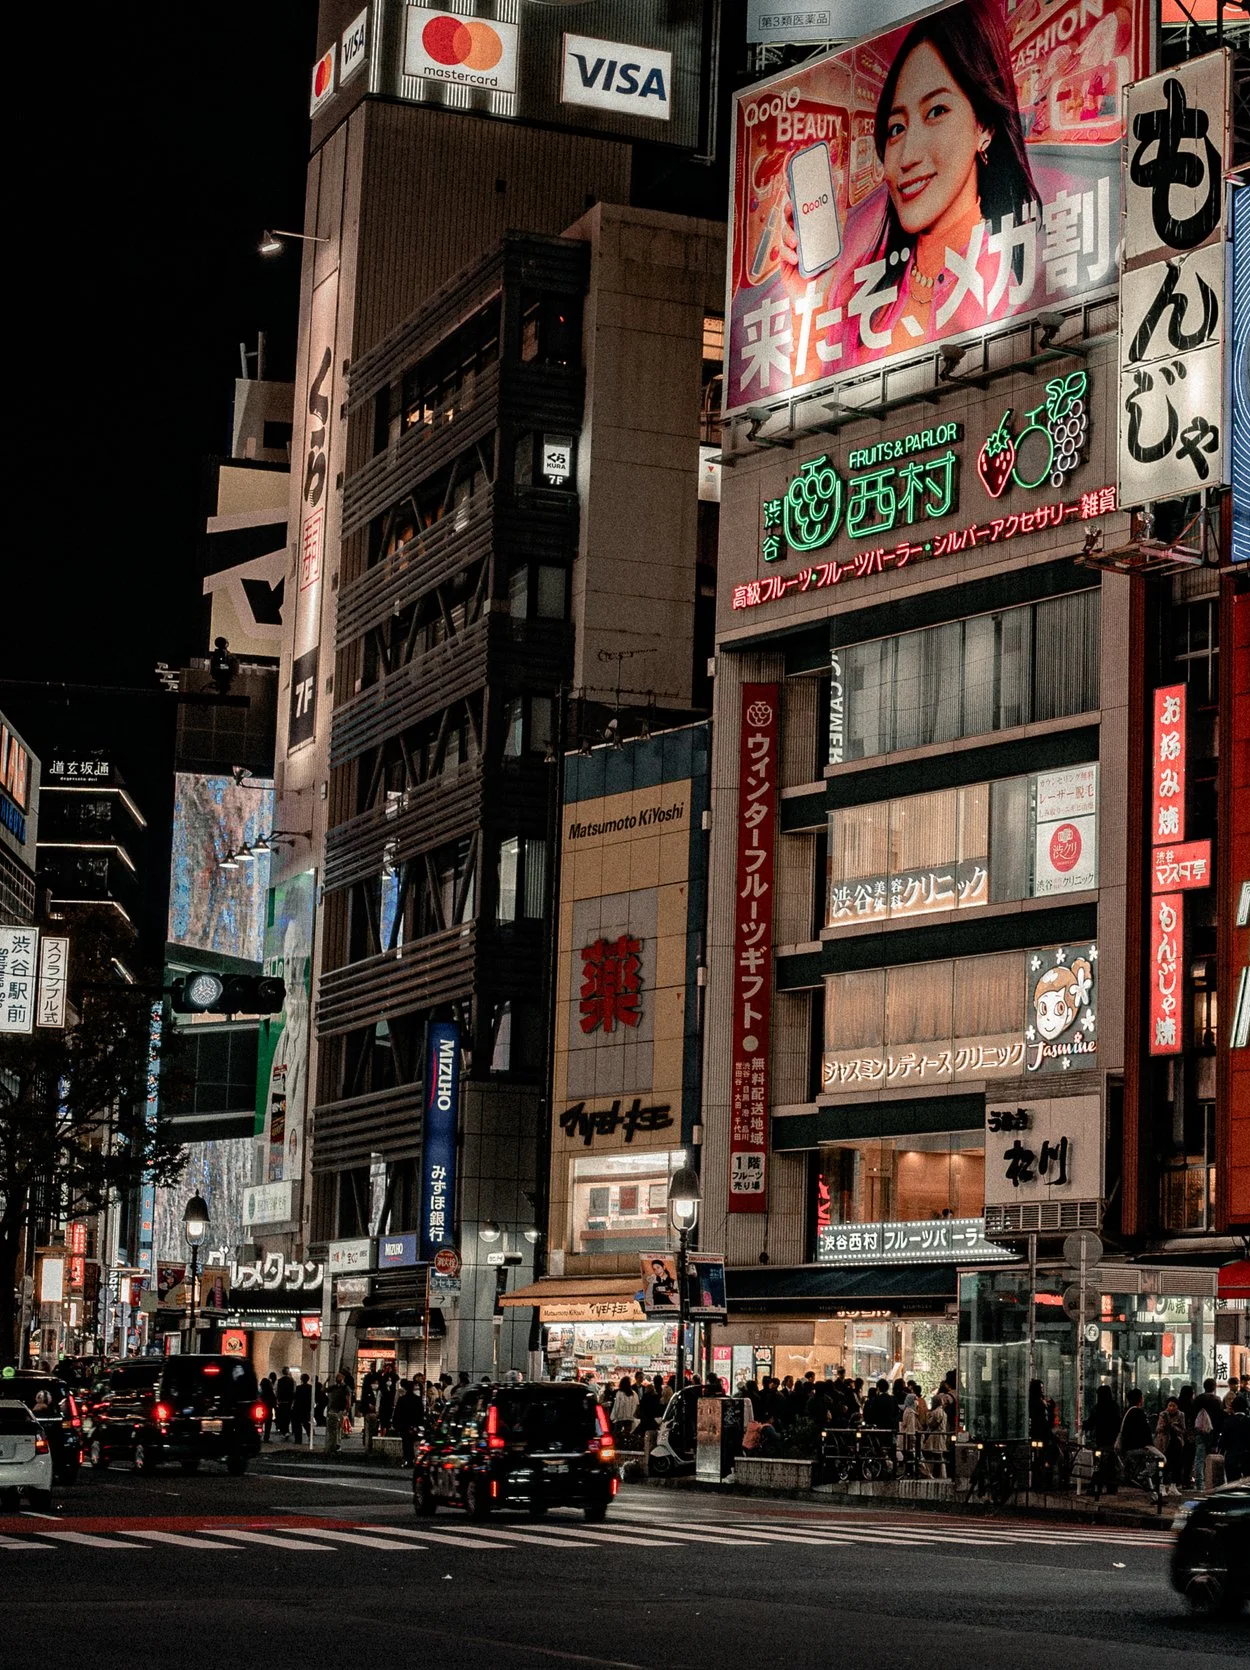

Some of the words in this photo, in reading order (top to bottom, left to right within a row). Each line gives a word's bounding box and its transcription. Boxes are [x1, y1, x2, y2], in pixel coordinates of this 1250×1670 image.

[343, 23, 365, 65] VISA
[423, 65, 498, 88] mastercard
[568, 52, 667, 101] VISA
[744, 86, 800, 127] Qoo10
[776, 110, 842, 142] BEAUTY
[802, 193, 828, 215] Qoo10
[1126, 77, 1222, 481] もんじゃ
[546, 463, 567, 471] KURA
[548, 475, 564, 485] 7F
[845, 450, 957, 540] 西村
[762, 499, 782, 562] 渋谷
[295, 675, 314, 718] 7F
[48, 760, 110, 776] 道玄坂通
[1158, 695, 1183, 836] お好み焼
[568, 814, 637, 840] Matsumoto
[740, 732, 770, 1029] ウインターフルーツギフト
[8, 935, 31, 1023] 渋谷駅前
[579, 934, 644, 1034] 薬
[1155, 901, 1179, 1047] もんじゃ焼
[437, 1038, 455, 1112] MIZUHO
[1027, 1038, 1097, 1071] Jasmine
[750, 1057, 766, 1146] 無料配送地域
[732, 1171, 763, 1181] フルーツ
[429, 1164, 447, 1242] みずほ銀行
[384, 1242, 404, 1256] MIZUHO
[823, 1233, 878, 1251] 渋谷西村
